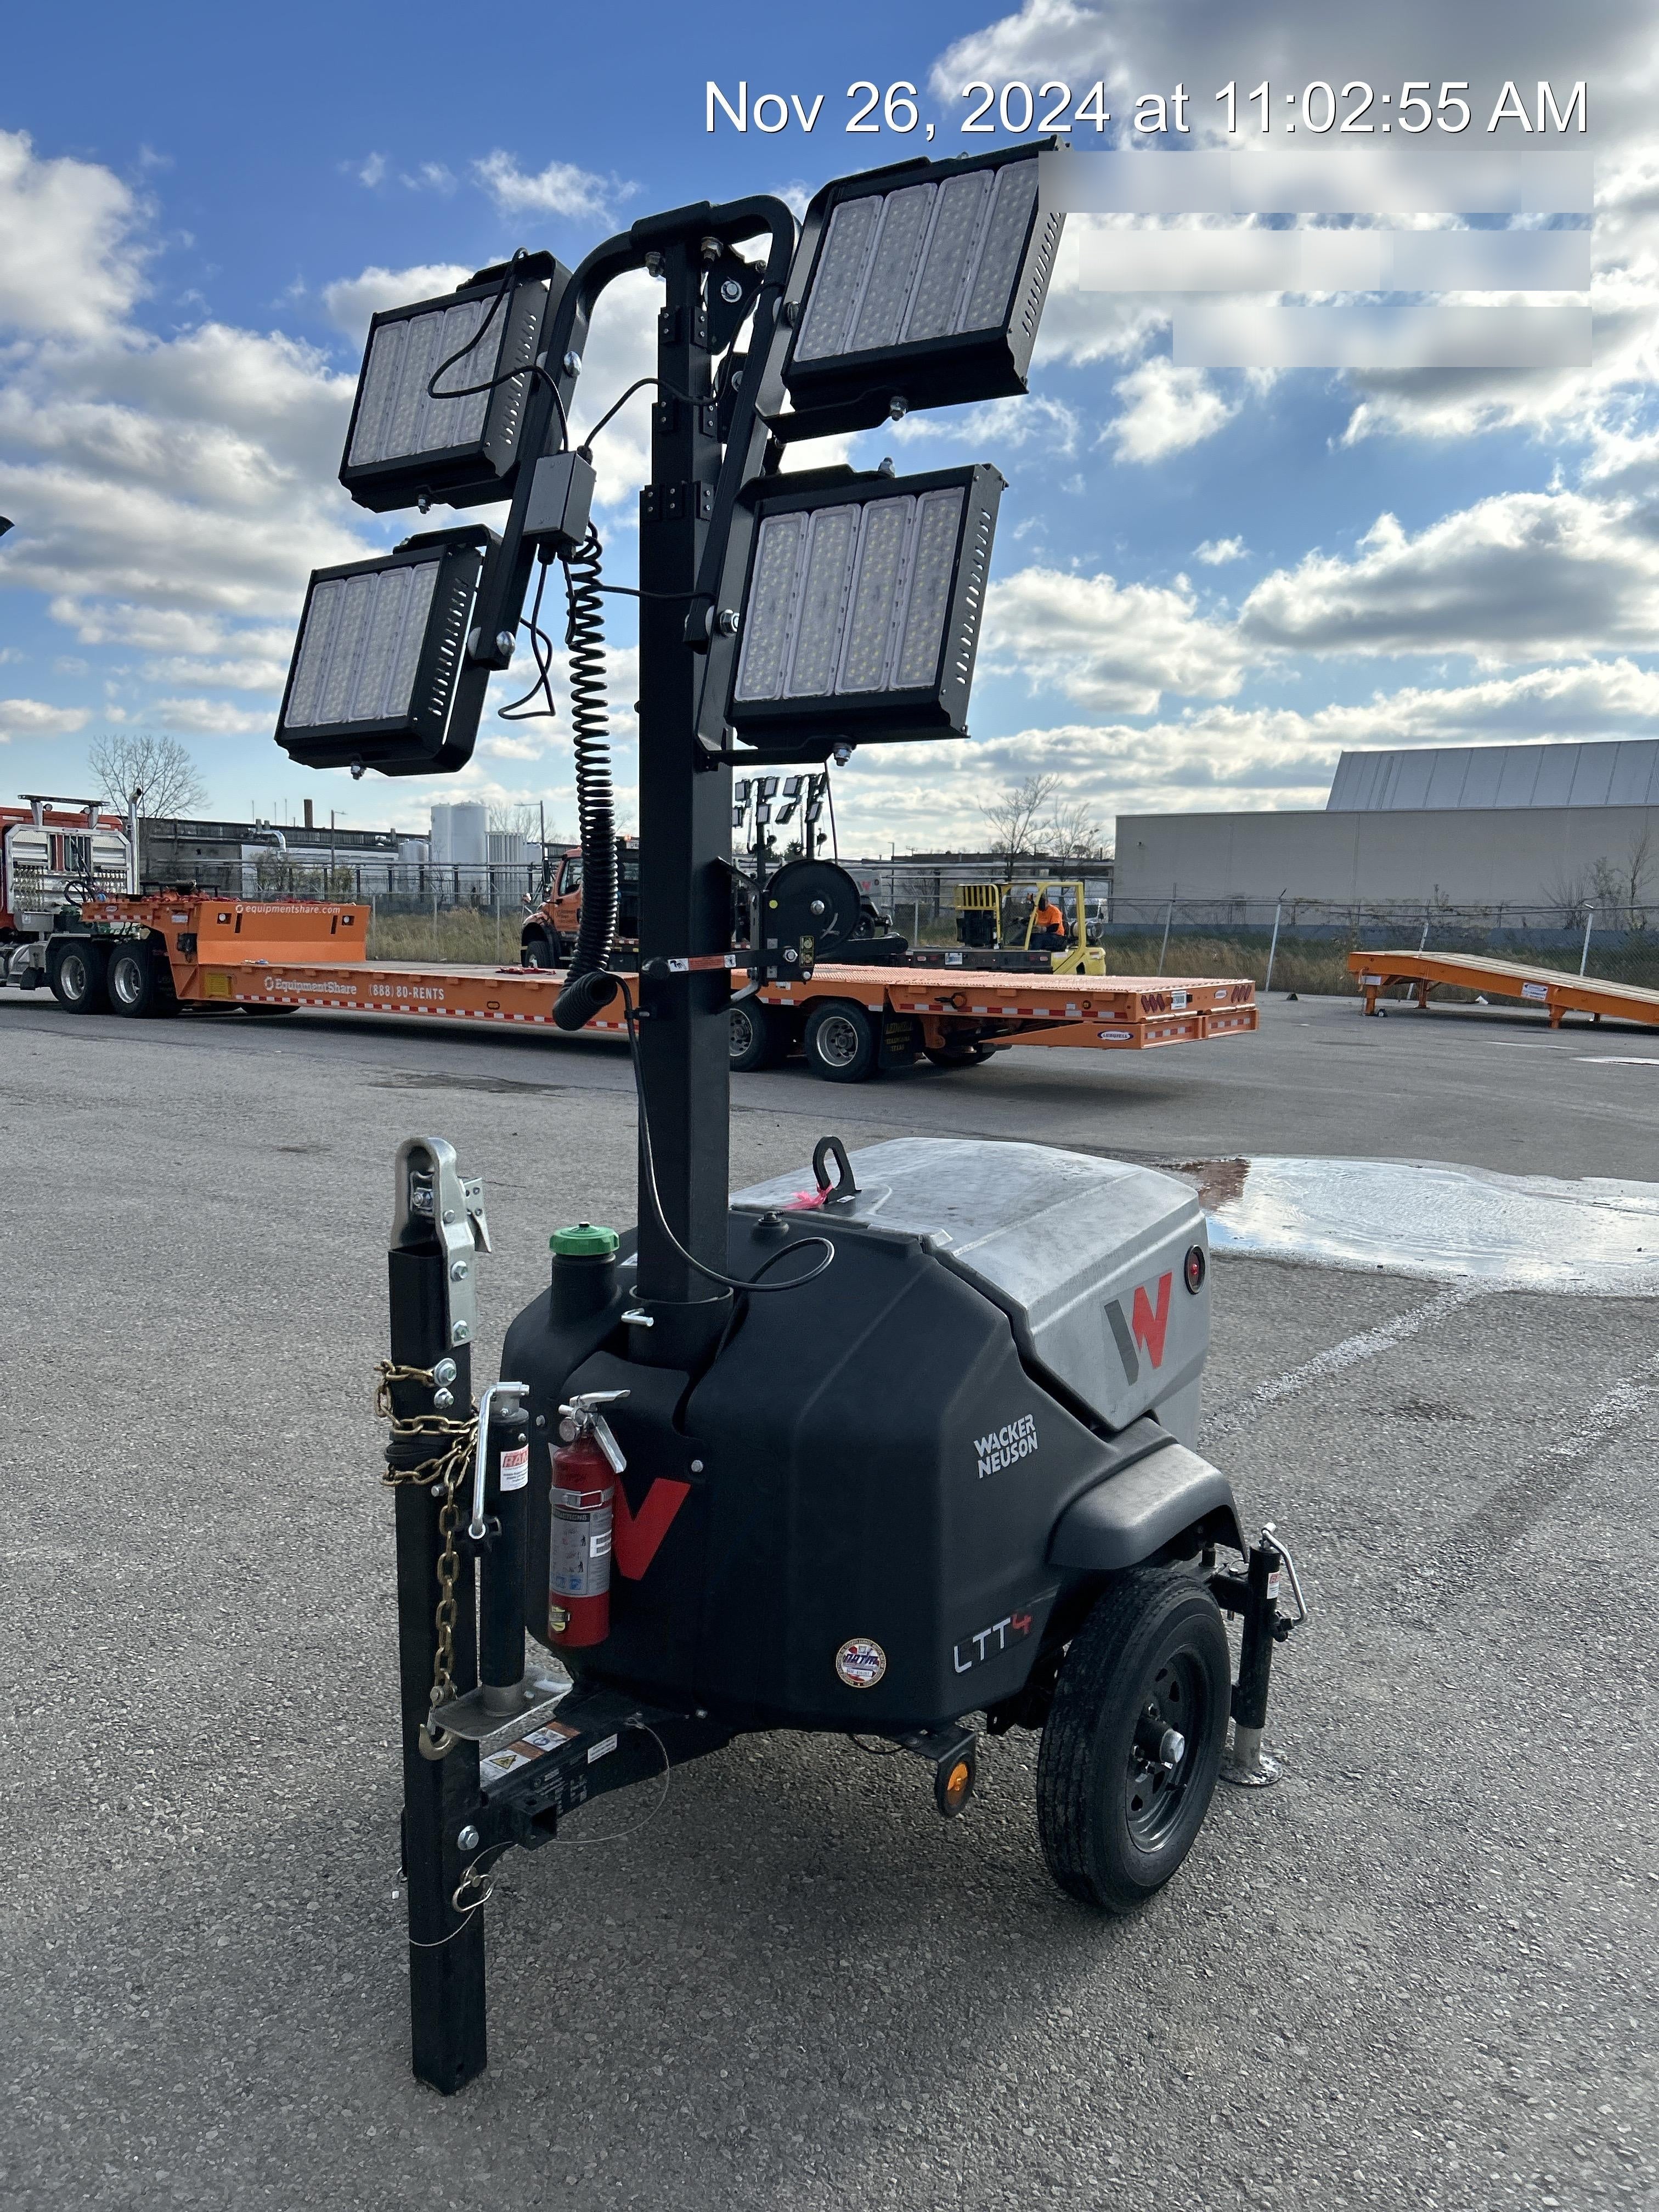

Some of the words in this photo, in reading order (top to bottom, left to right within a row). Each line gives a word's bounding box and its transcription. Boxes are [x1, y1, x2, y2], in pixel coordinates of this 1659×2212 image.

[245, 905, 340, 915] equipmentshare.com
[275, 978, 357, 995] EquipmentShare
[368, 984, 394, 997] (888)
[396, 985, 444, 1001] 80-RENTS
[974, 1414, 1036, 1457] WACKER
[978, 1431, 1038, 1479] NEUSON
[953, 1612, 1032, 1673] LTT4
